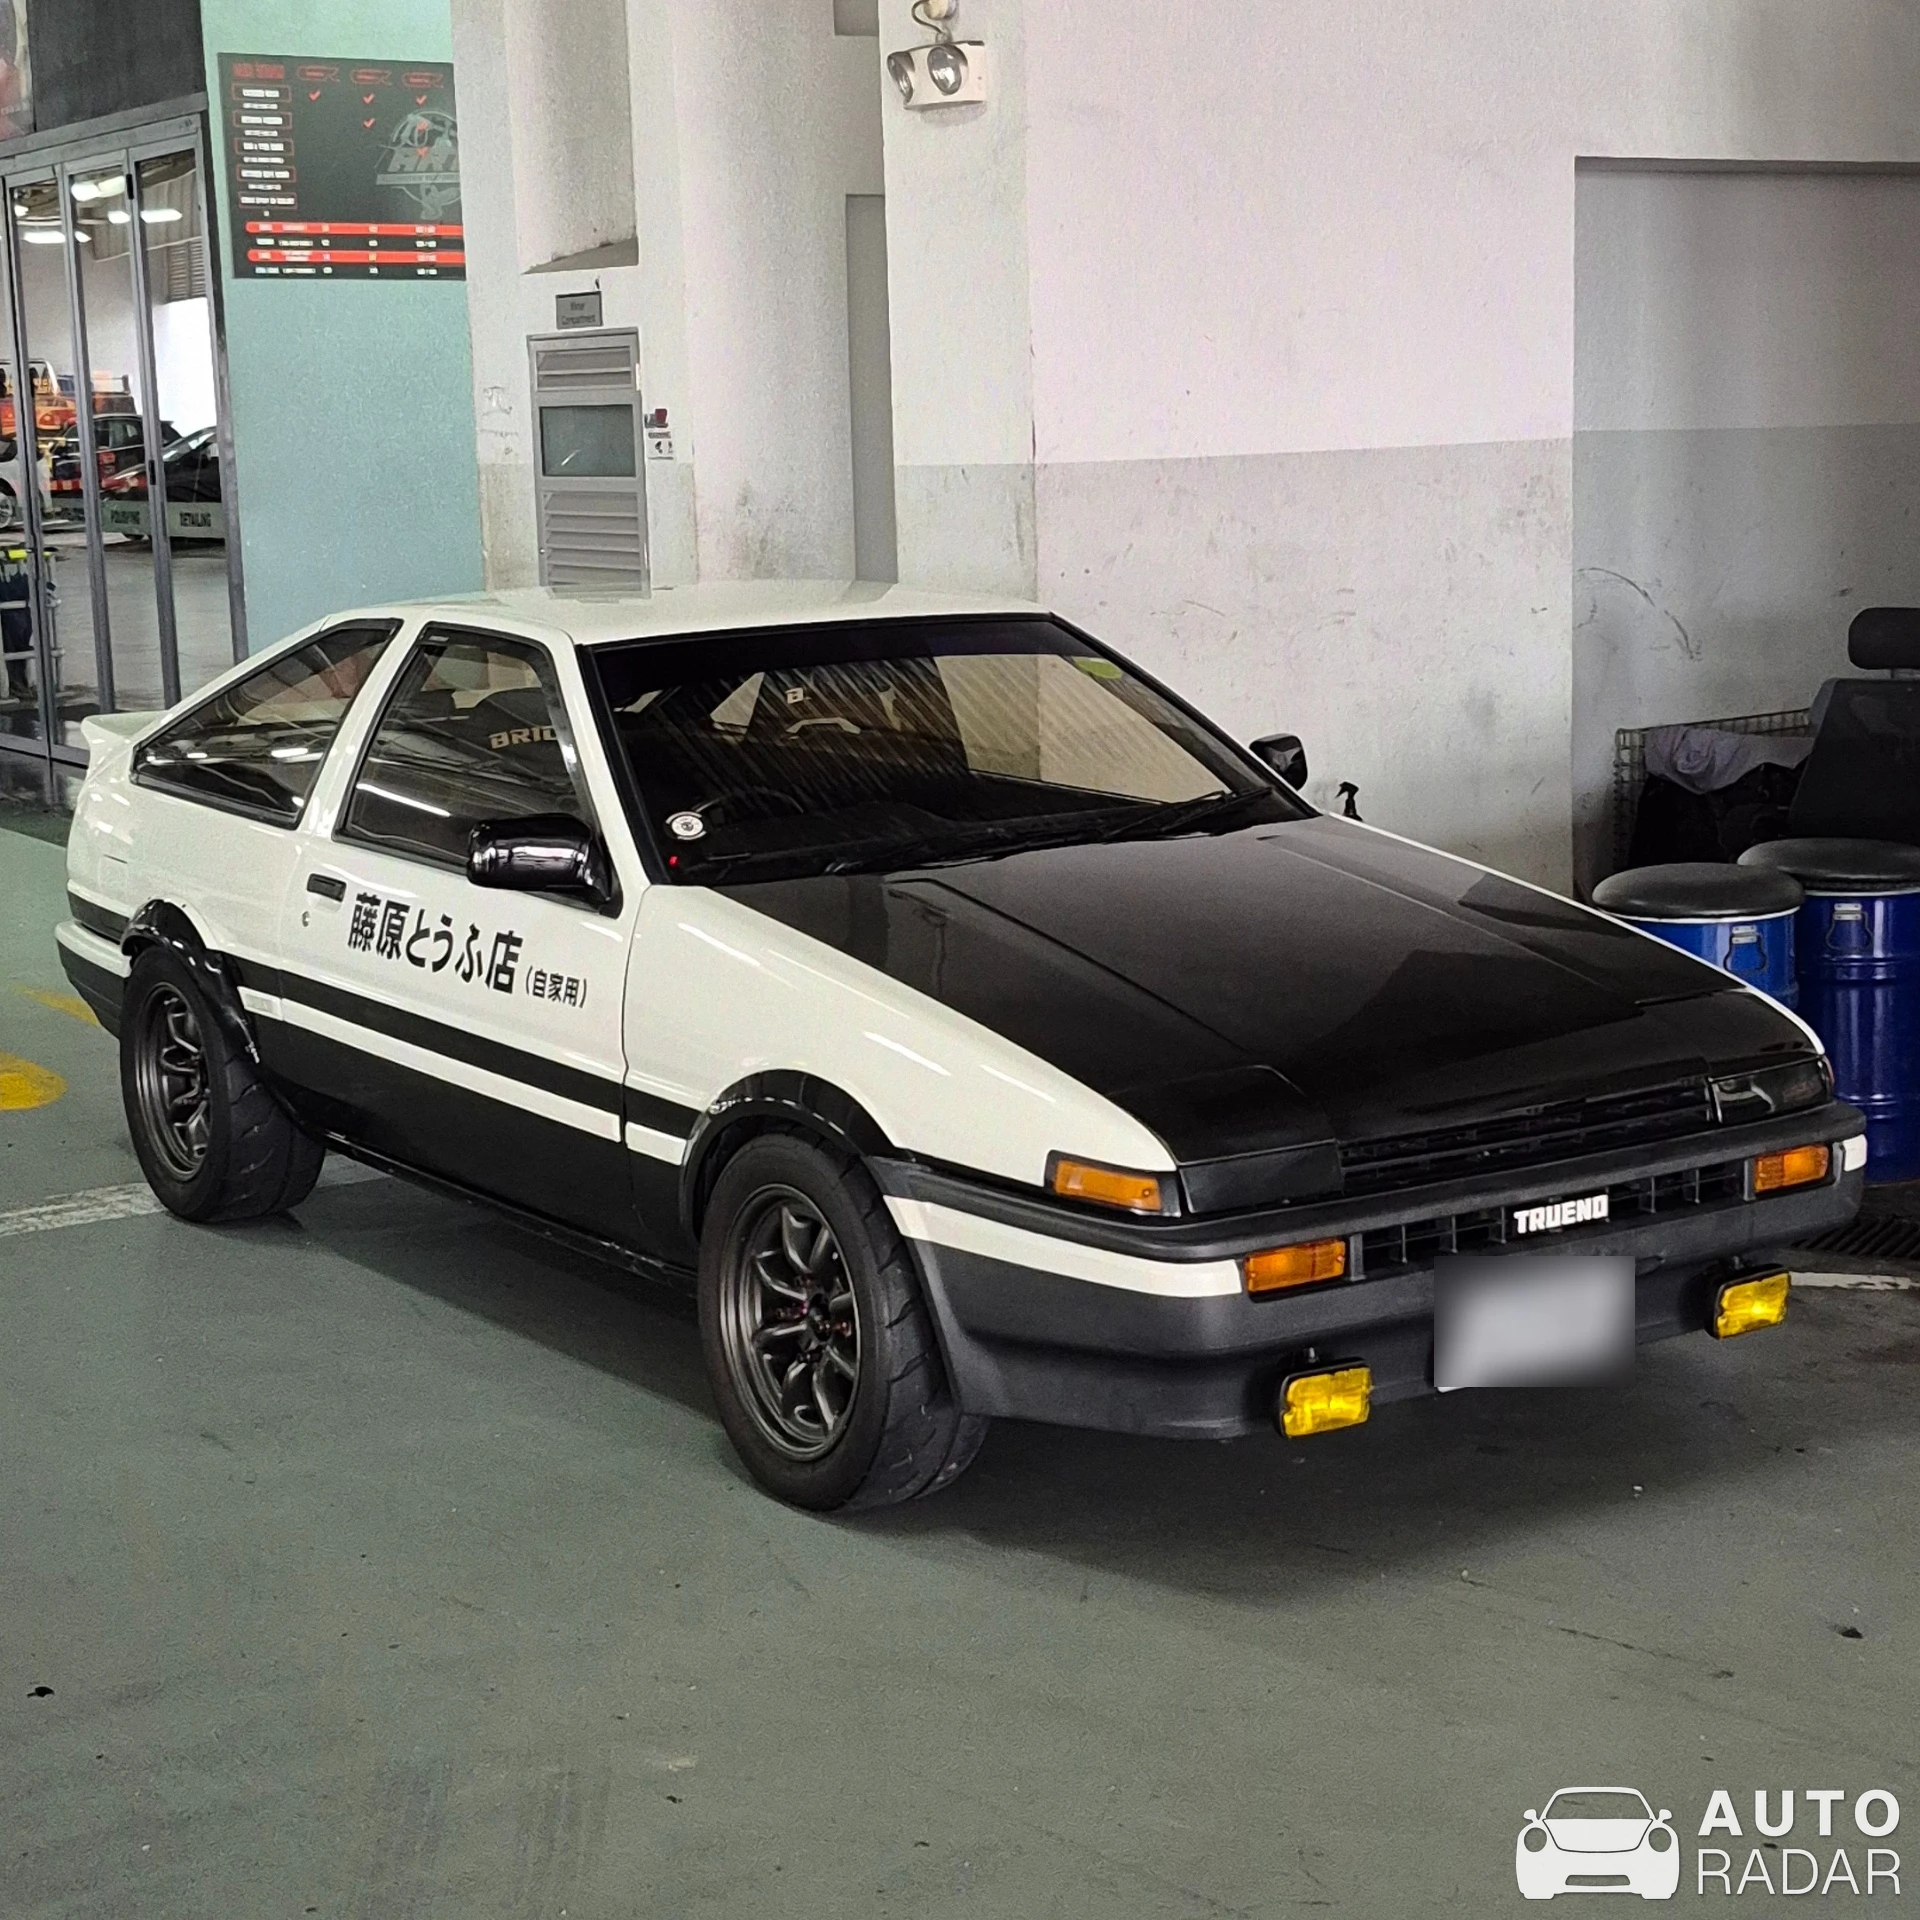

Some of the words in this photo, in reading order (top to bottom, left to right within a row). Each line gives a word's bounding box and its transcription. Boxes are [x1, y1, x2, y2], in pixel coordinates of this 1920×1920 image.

[348, 892, 523, 994] 藤原とうふ店
[1513, 1194, 1609, 1234] TRUENO
